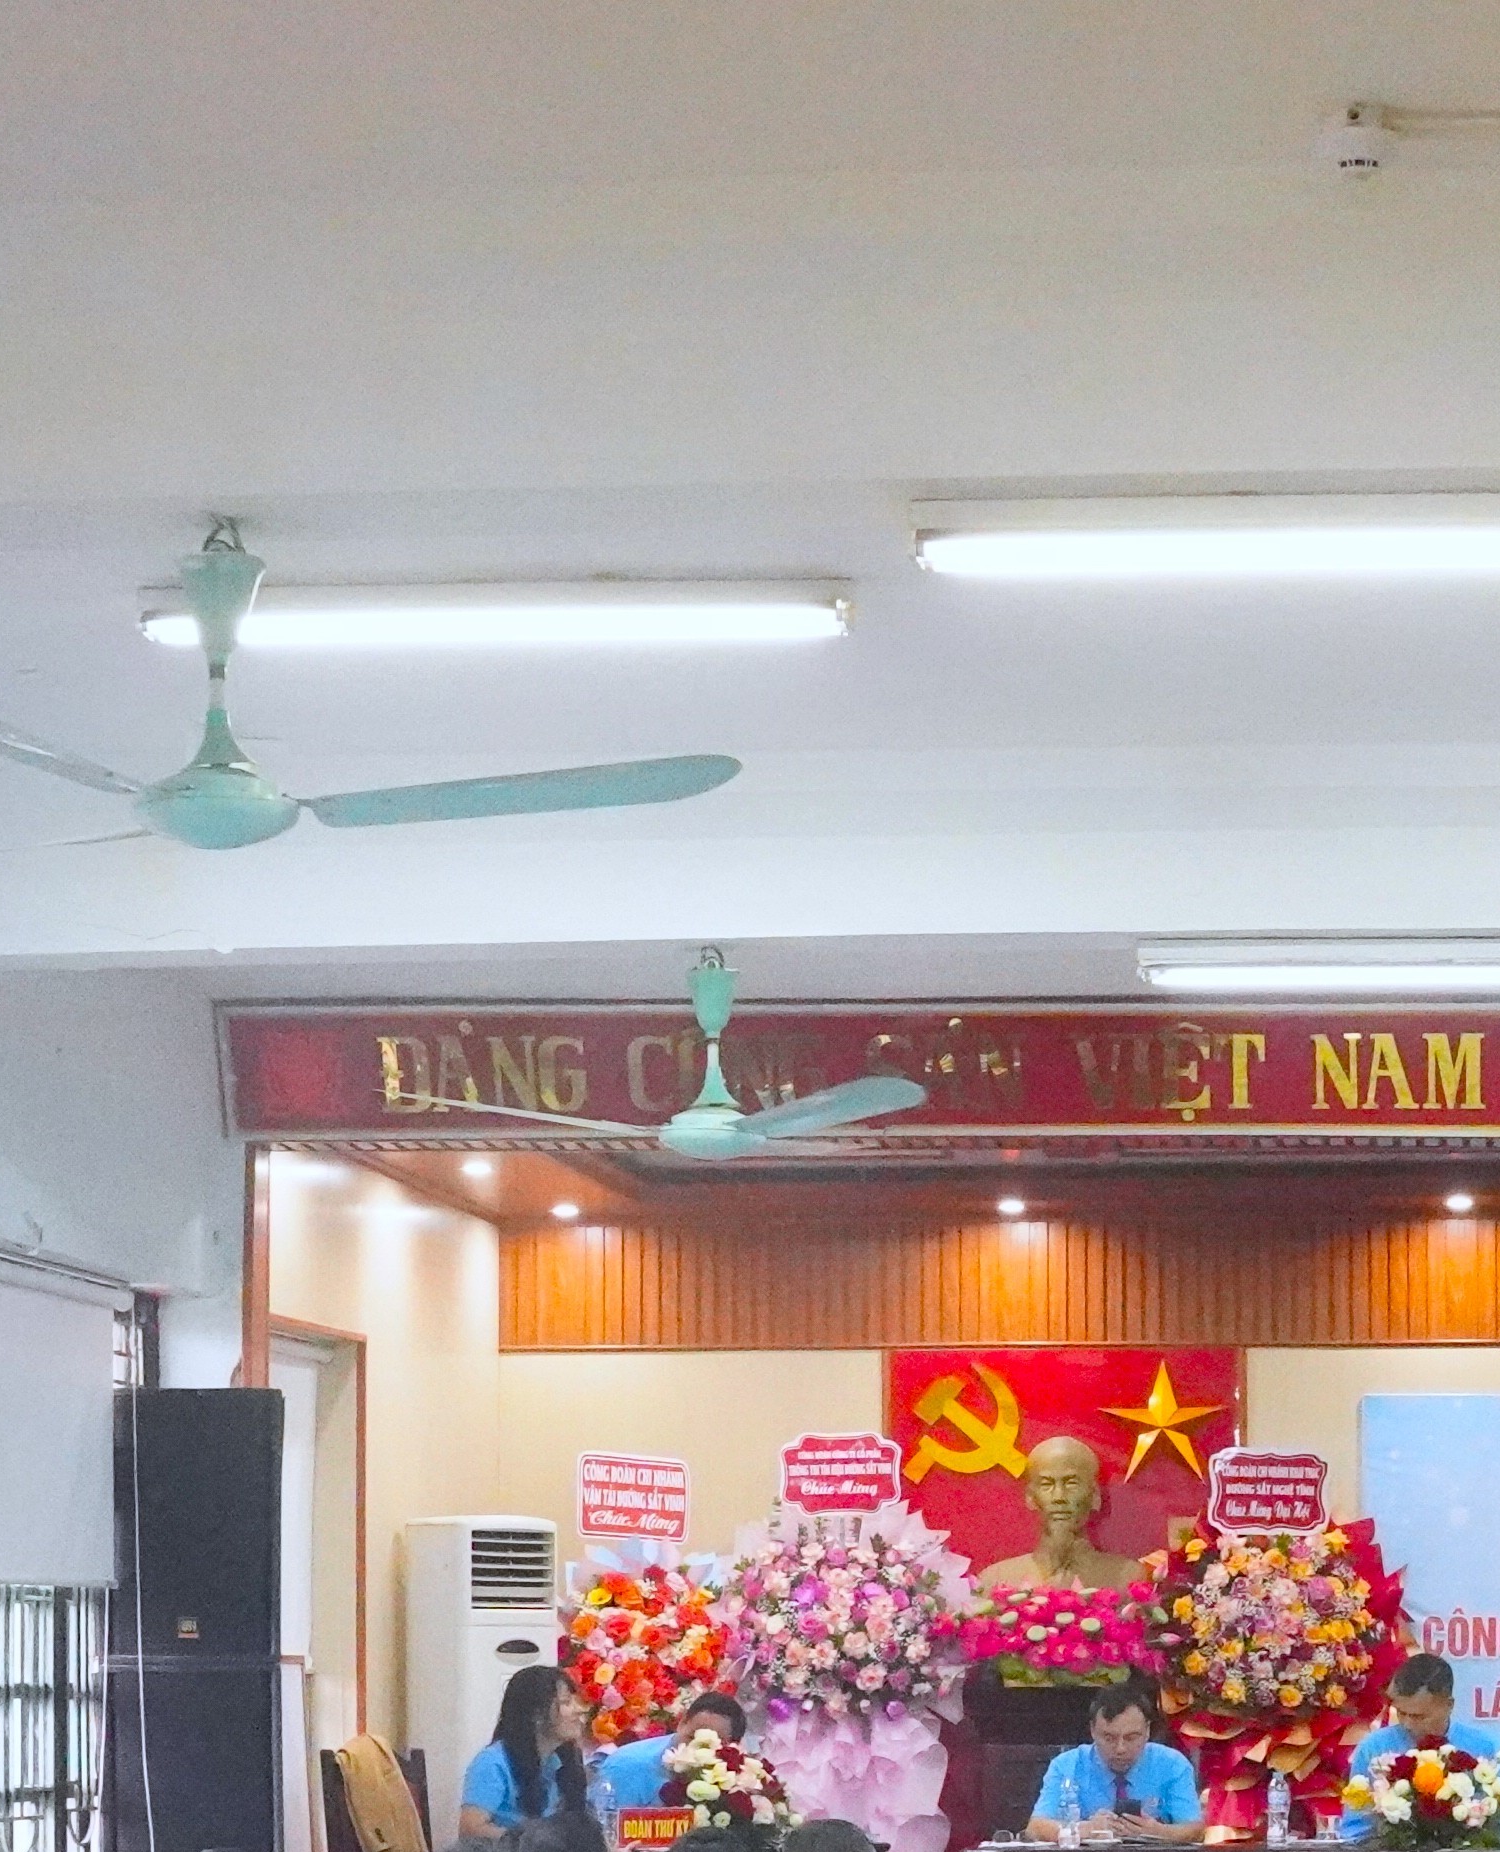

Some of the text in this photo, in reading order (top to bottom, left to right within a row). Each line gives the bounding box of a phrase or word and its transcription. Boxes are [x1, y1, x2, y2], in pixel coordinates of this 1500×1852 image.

[1070, 1020, 1266, 1122] VIỆT
[1310, 1032, 1486, 1110] NAM
[583, 1461, 610, 1482] CÔNG
[588, 1510, 631, 1526] Chúc
[624, 1816, 652, 1838] ĐOÀN
[654, 1818, 676, 1838] THƯ
